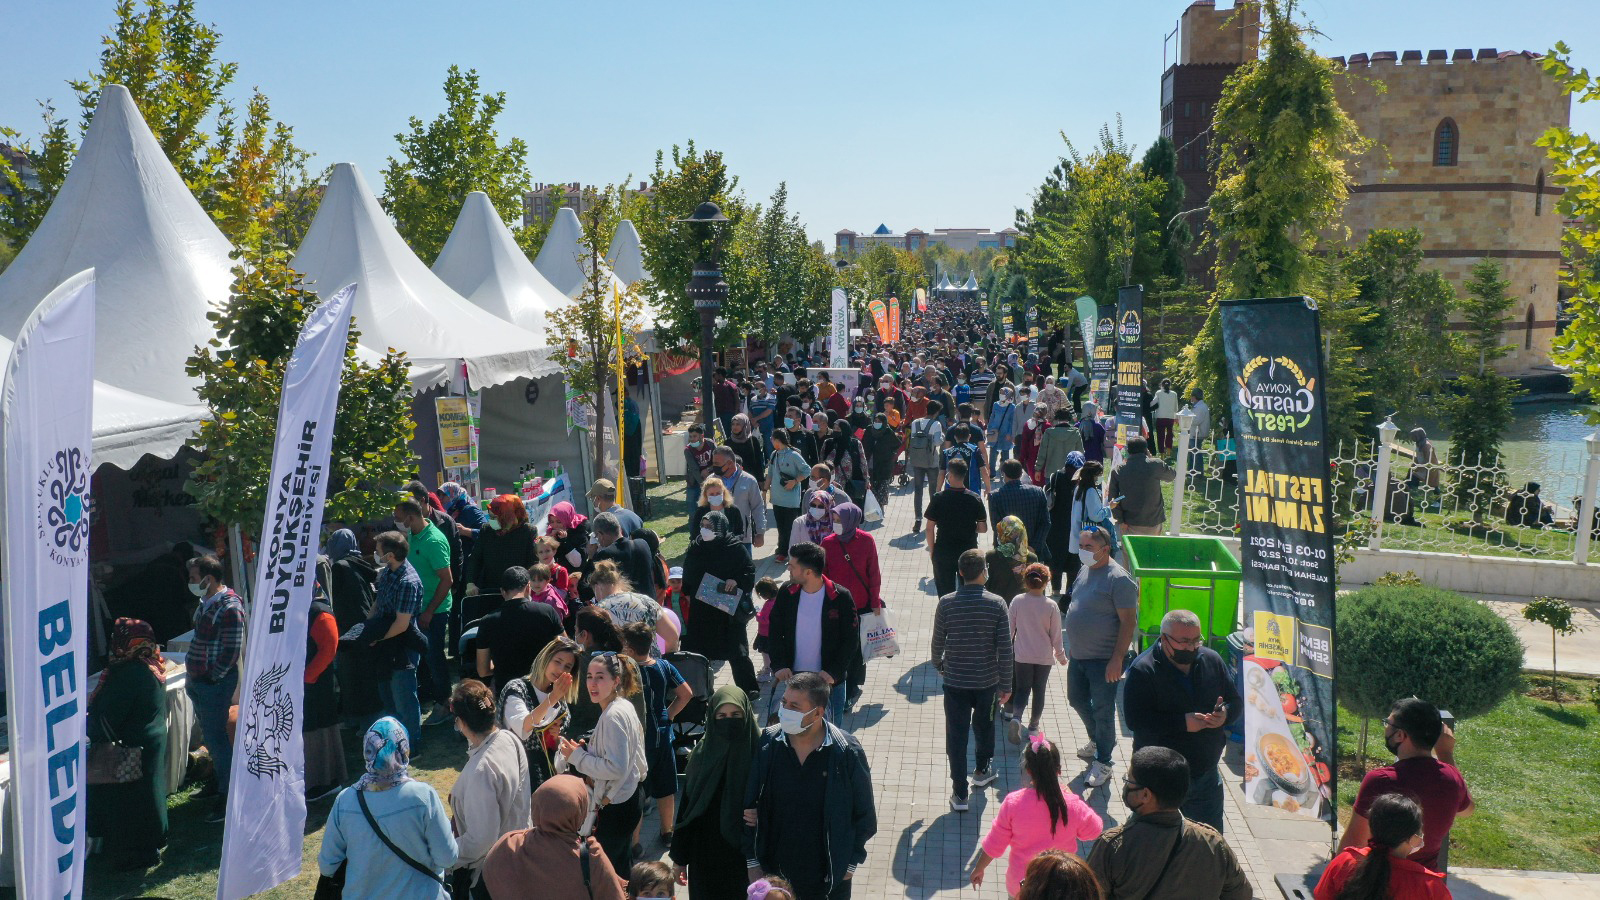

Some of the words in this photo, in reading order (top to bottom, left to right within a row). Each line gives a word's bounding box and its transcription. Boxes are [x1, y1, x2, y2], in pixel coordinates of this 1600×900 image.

[50, 547, 80, 568] KONYA
[265, 472, 292, 580] KONYA
[269, 420, 317, 634] BÜYÜKŞEHİR
